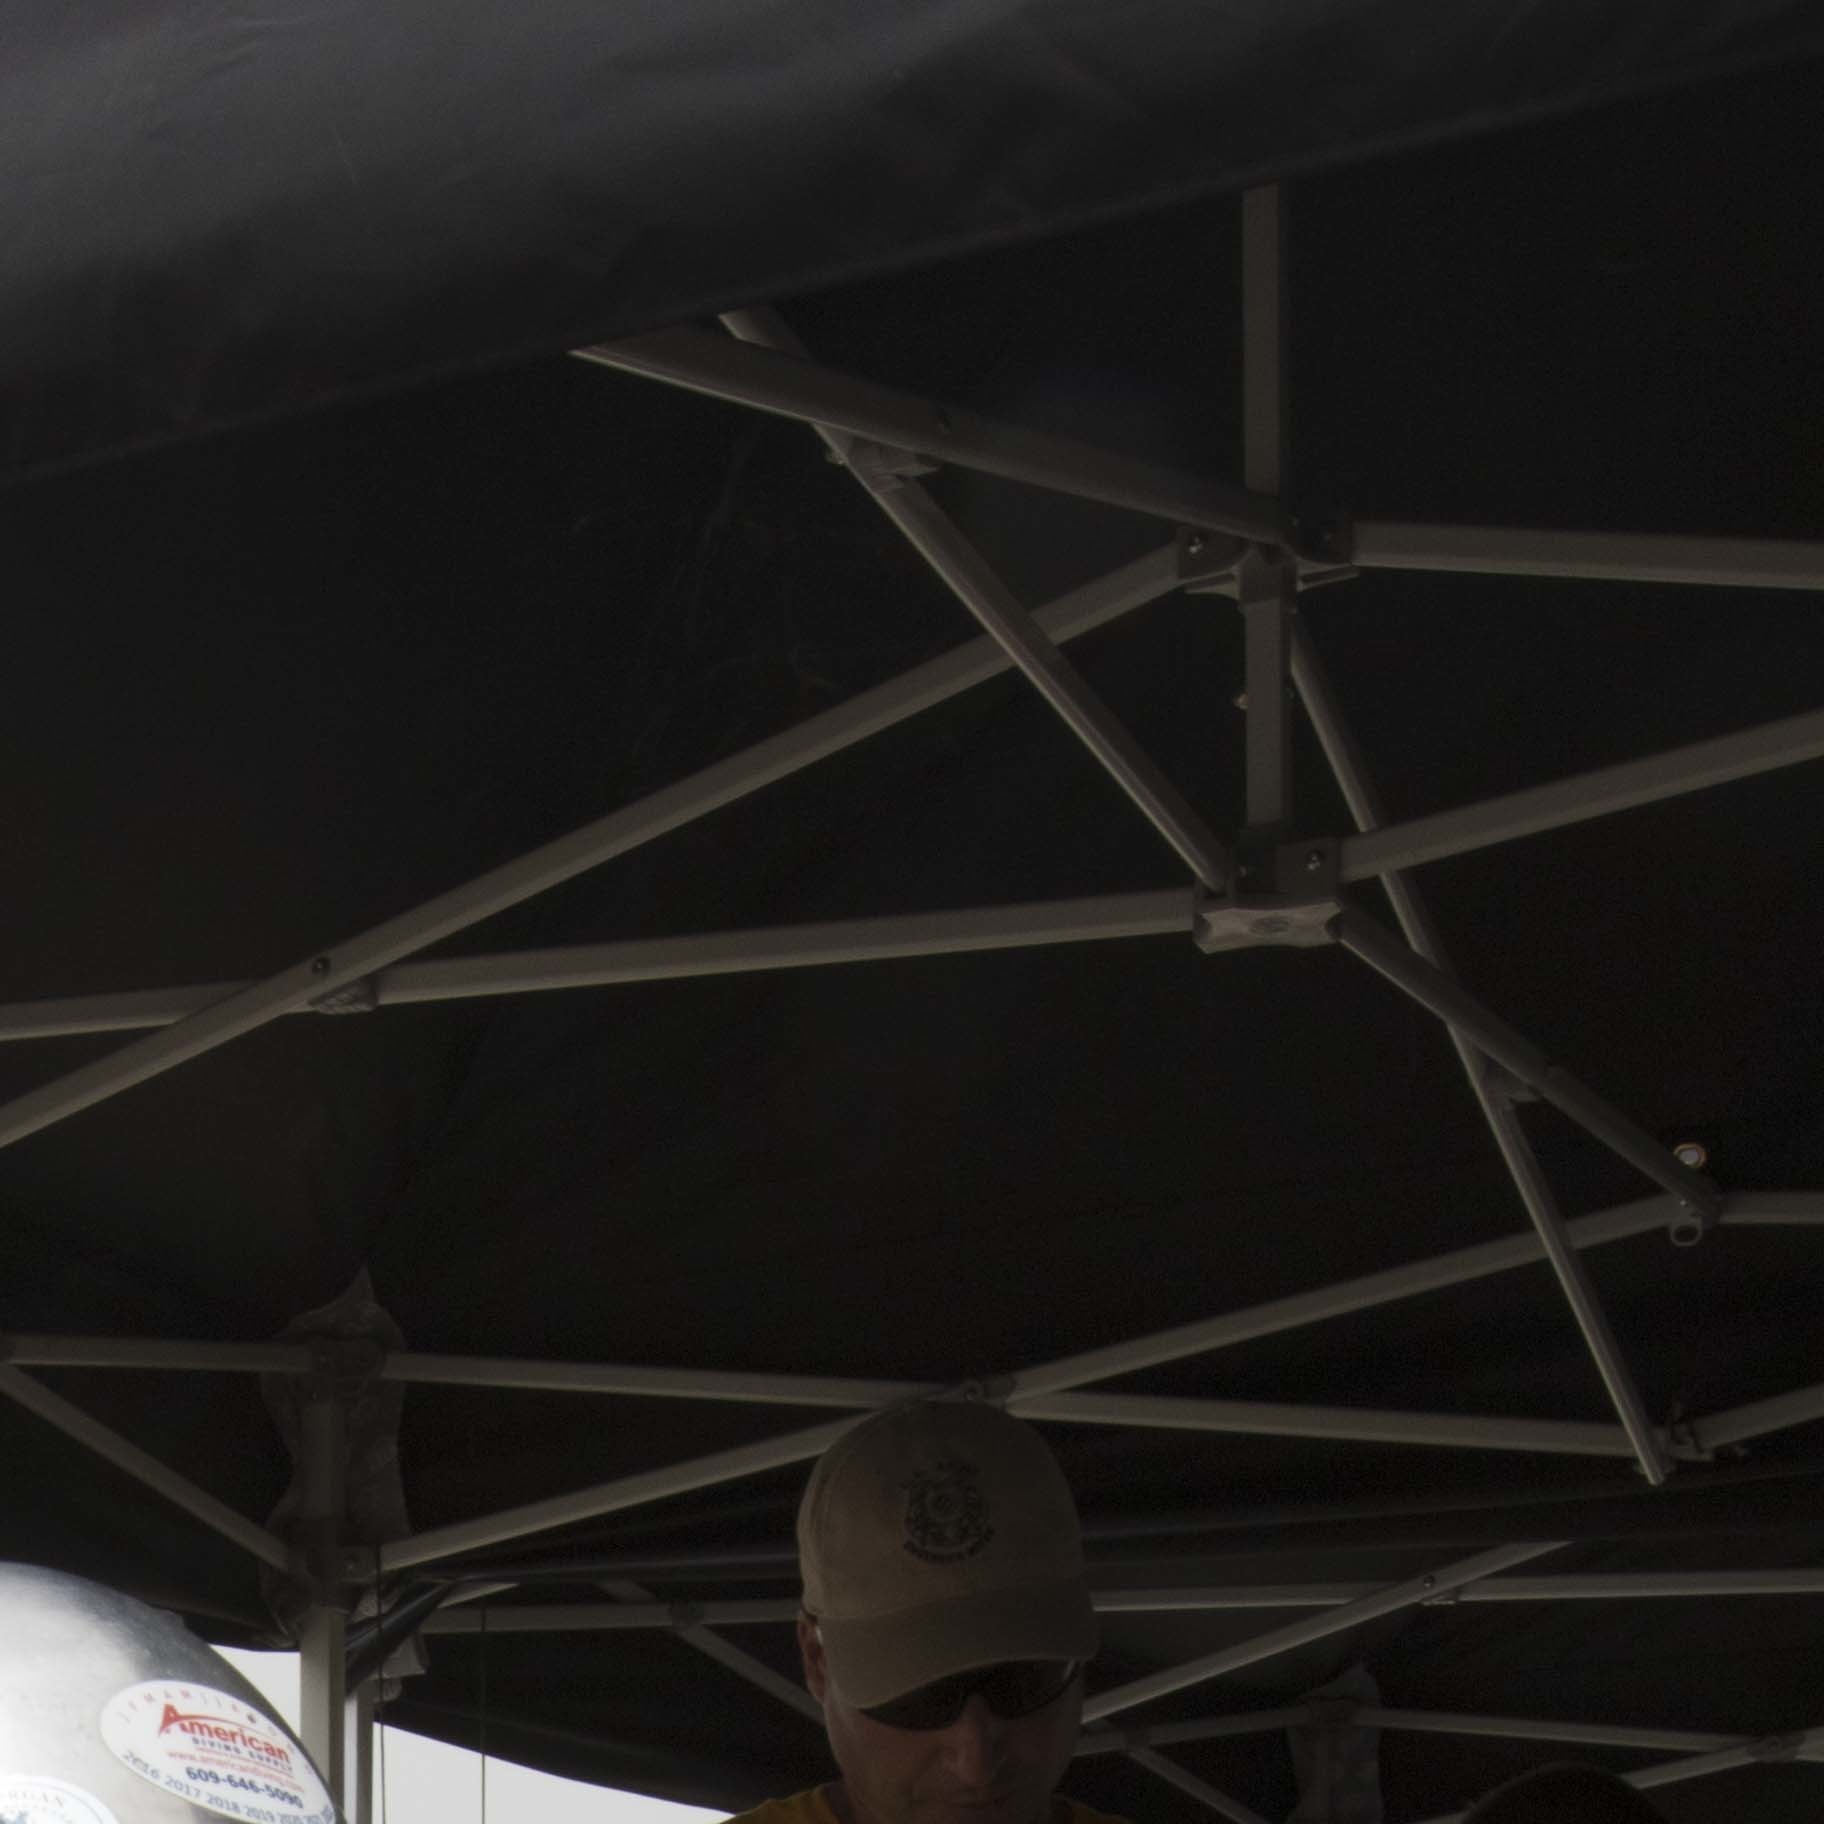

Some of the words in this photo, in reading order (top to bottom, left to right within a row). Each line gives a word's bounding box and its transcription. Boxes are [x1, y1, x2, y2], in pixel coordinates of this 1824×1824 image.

[158, 1702, 290, 1763] American
[191, 1737, 241, 1755] DIVING
[164, 1775, 201, 1799] 2017
[207, 1793, 242, 1815] 2018
[244, 1806, 277, 1824] 2019
[185, 1766, 305, 1809] 609-646-5090
